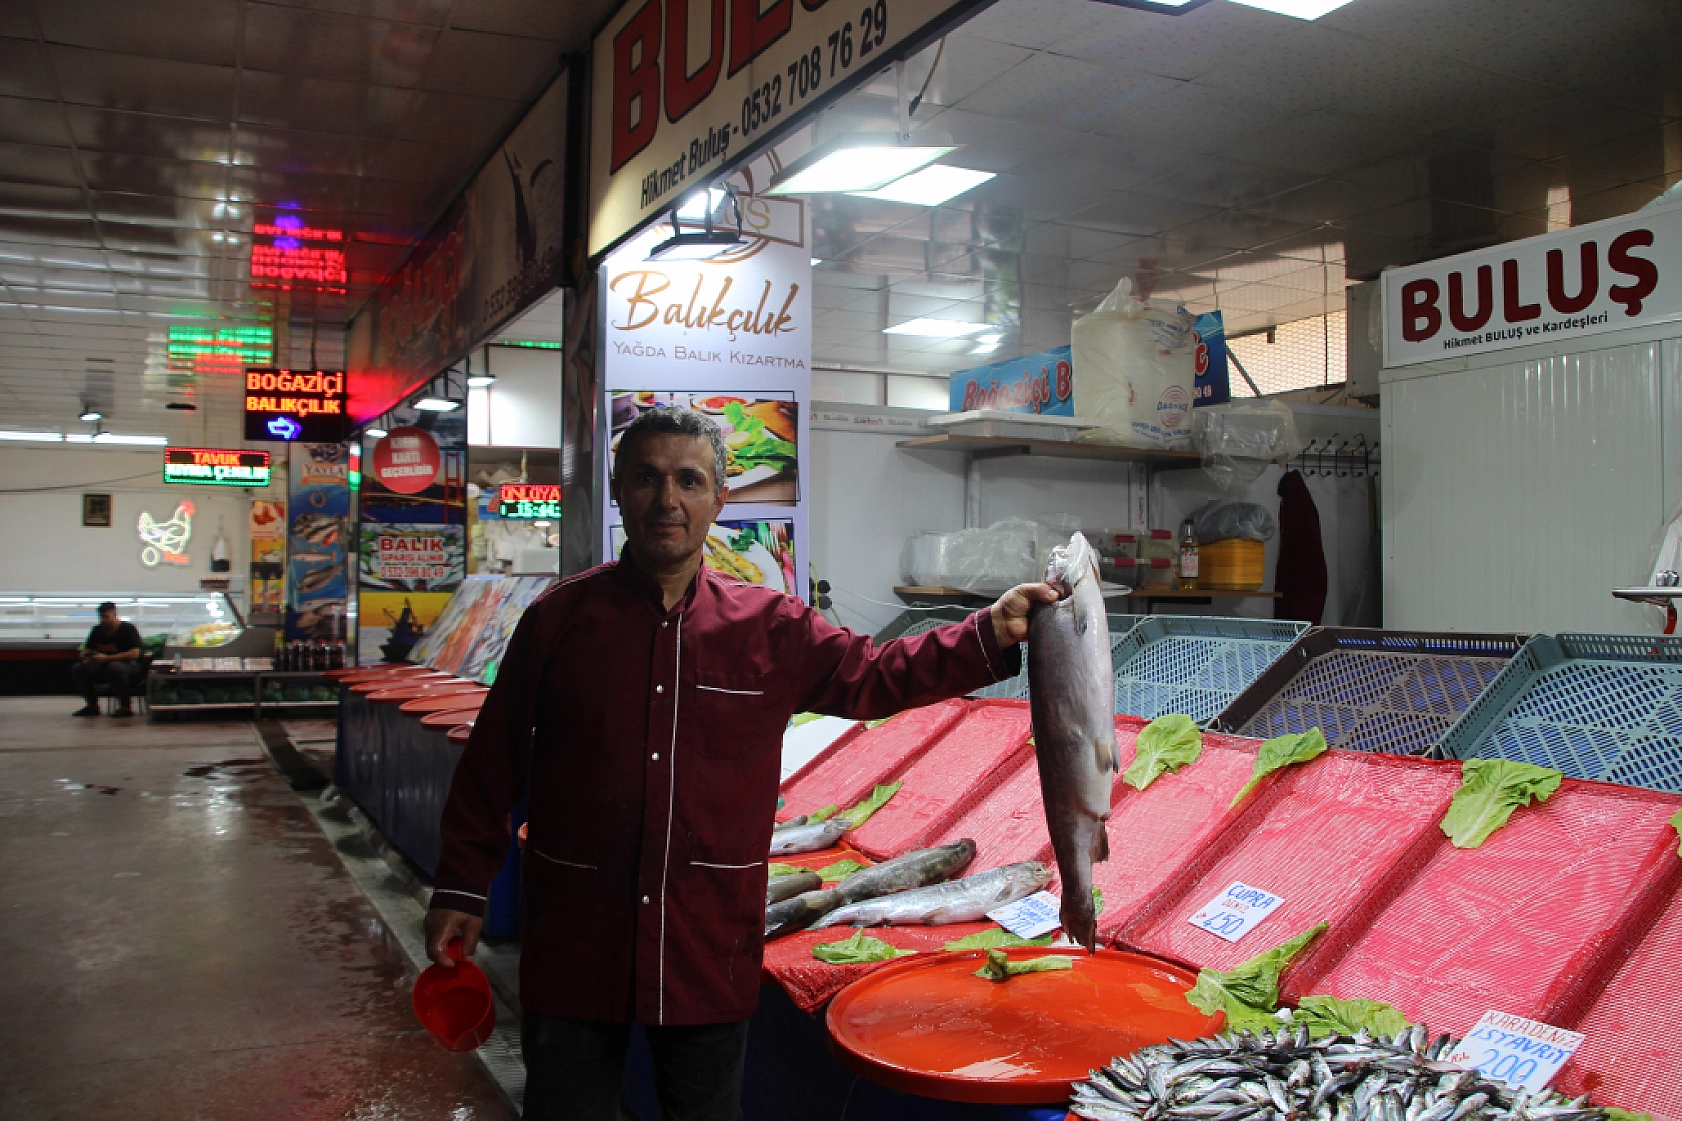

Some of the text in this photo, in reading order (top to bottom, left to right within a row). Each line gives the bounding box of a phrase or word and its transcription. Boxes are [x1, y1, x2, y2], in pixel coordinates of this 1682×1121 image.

[640, 151, 686, 210] Hikmet
[688, 122, 731, 162] Buluş
[742, 75, 782, 137] 0532
[788, 45, 821, 106] 708
[828, 22, 853, 78] 76
[860, 0, 887, 57] 29
[1401, 228, 1659, 343] BULUŞ
[609, 269, 799, 342] Balıkçılık
[1443, 310, 1609, 350] Hikmet BULUŞ ve Kardeşleri
[674, 346, 722, 362] BALIK
[246, 369, 343, 398] BOĞAZİÇİ
[246, 396, 341, 418] BALIKÇILIK
[193, 451, 240, 466] TAVUK
[380, 537, 445, 552] BALIK
[1468, 1048, 1538, 1084] 200
